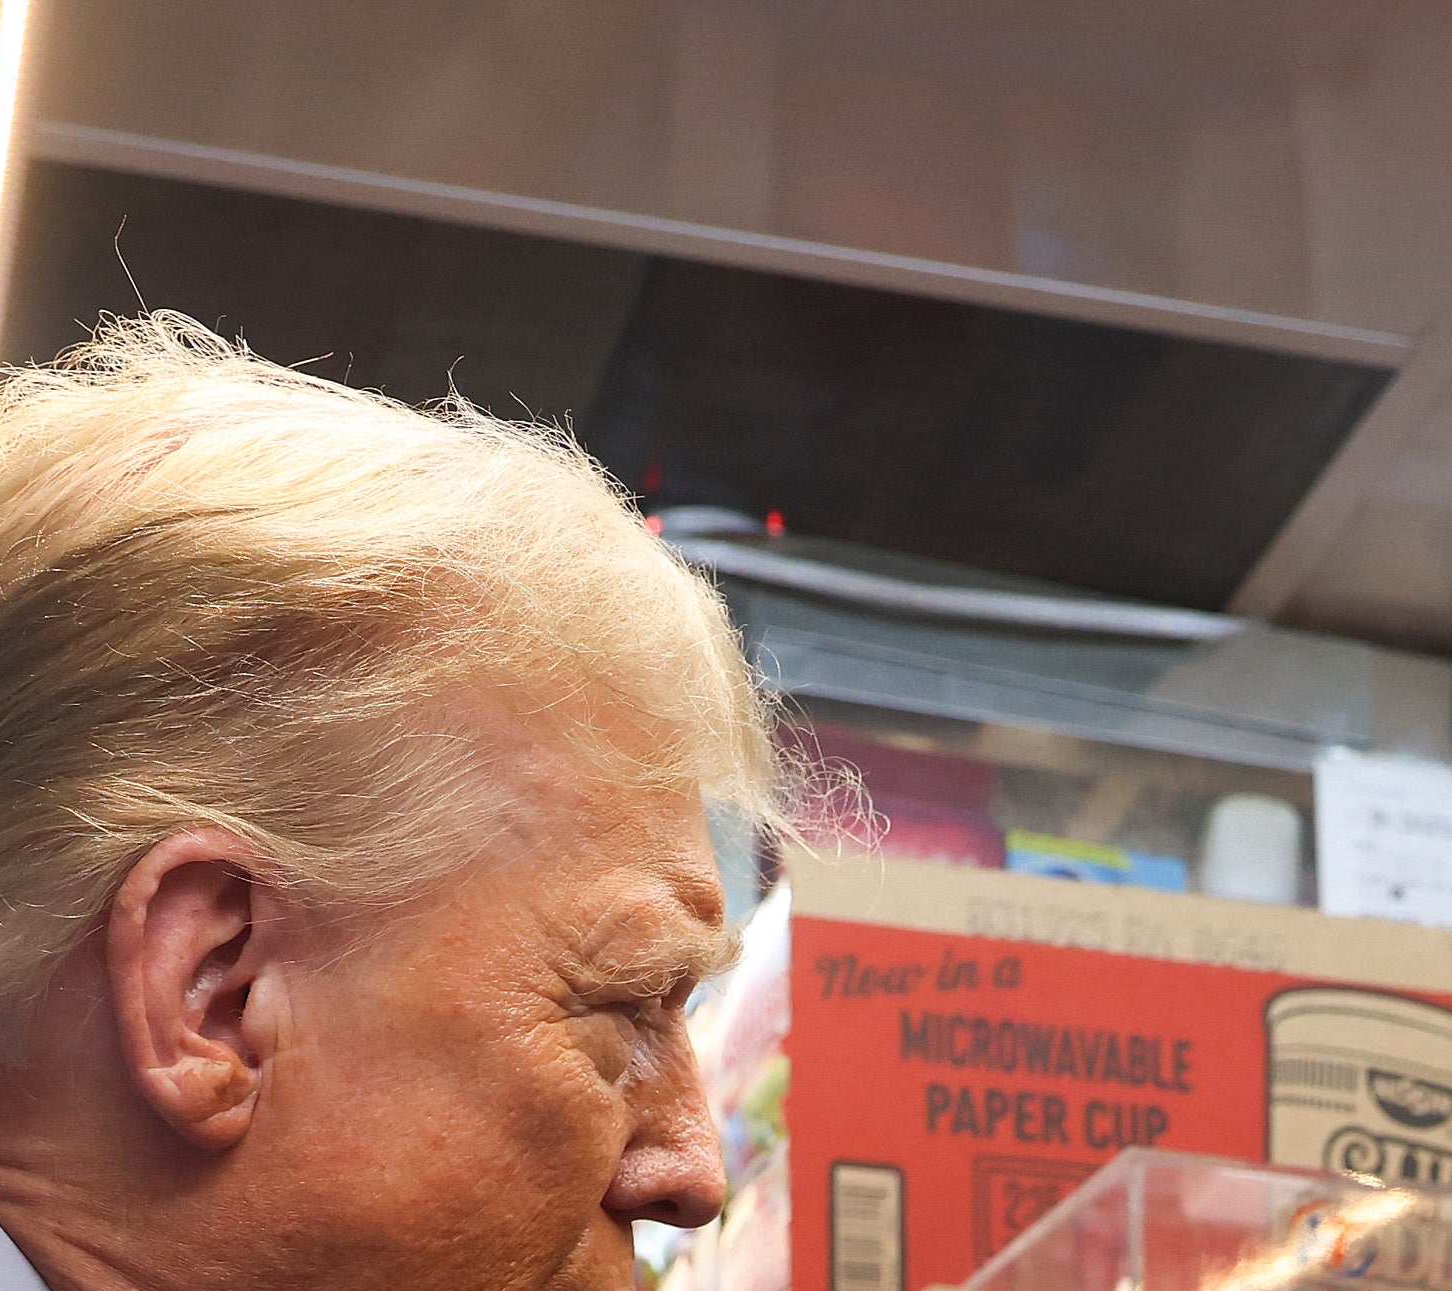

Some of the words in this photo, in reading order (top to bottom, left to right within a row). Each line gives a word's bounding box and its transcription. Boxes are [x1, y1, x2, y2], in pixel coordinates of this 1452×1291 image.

[814, 953, 920, 1000] Now
[935, 947, 980, 992] in
[991, 957, 1023, 989] a
[898, 1011, 1194, 1095] MICROWAVABLE
[924, 1084, 1072, 1147] PAPER
[1082, 1099, 1171, 1149] CUP
